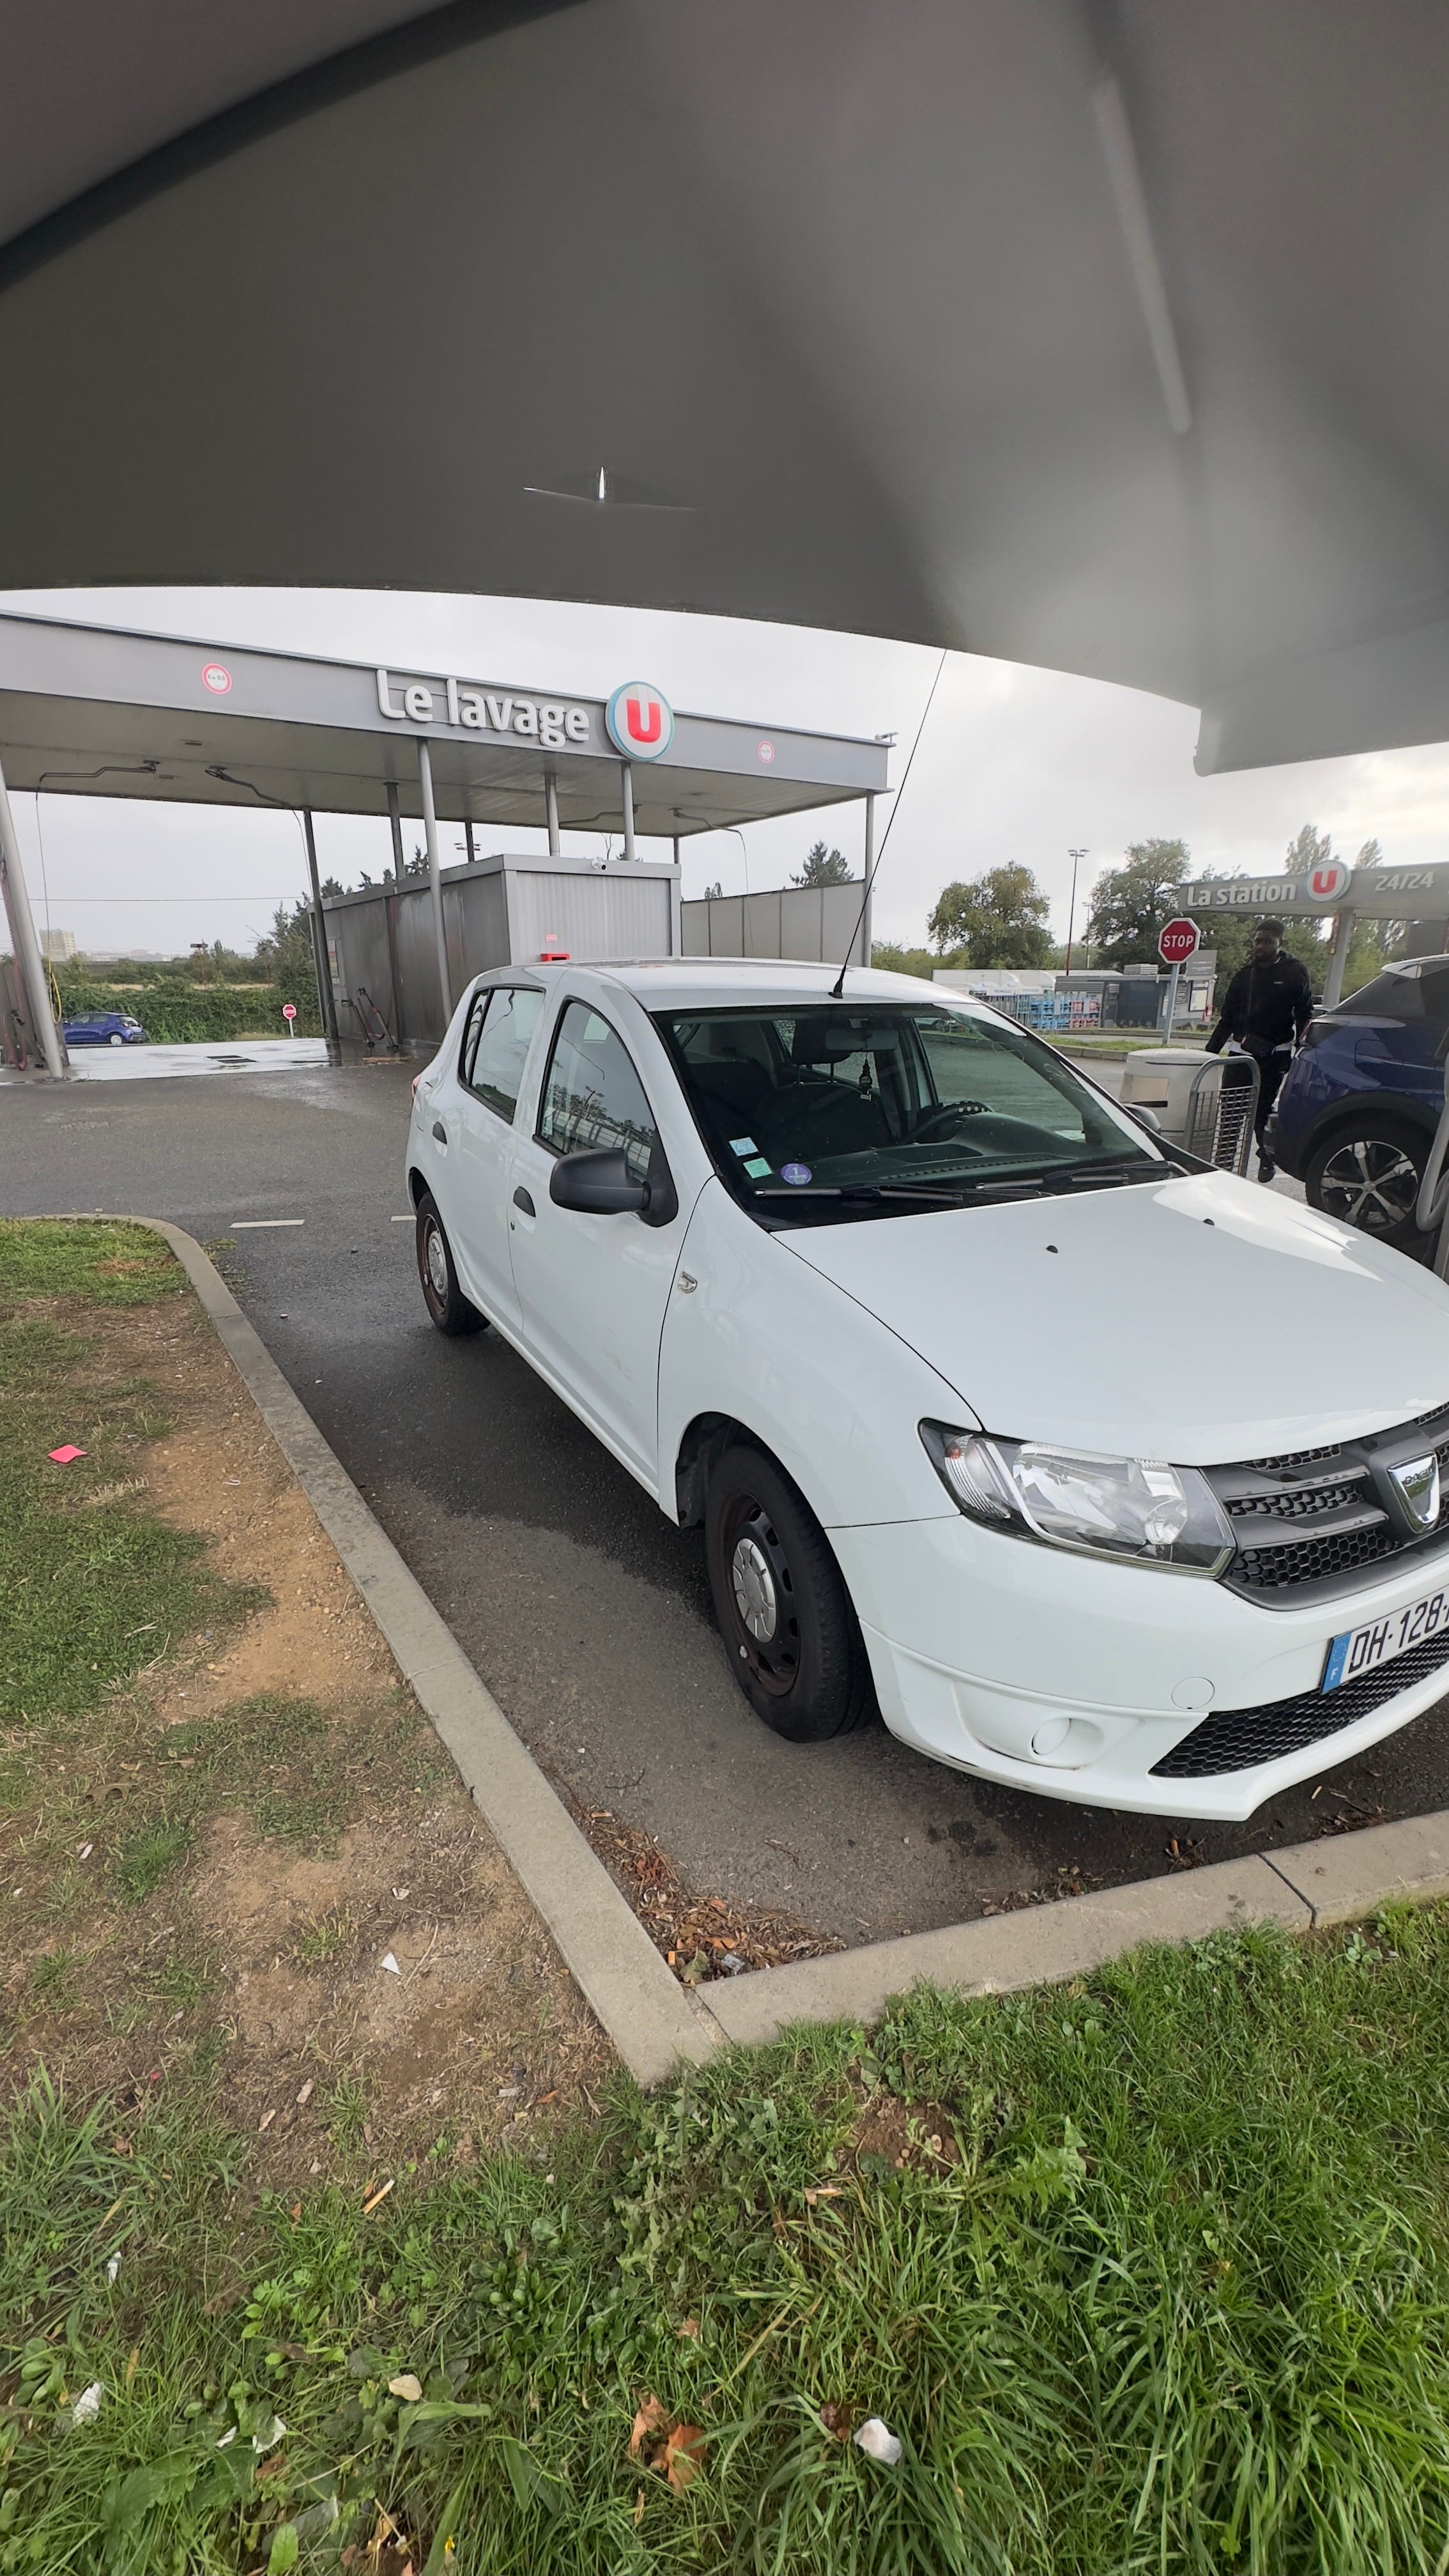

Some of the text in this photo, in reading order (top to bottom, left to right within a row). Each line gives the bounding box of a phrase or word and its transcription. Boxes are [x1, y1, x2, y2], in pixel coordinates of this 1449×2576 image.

[378, 670, 661, 747] Le lavage U
[1187, 871, 1434, 907] La station U 24/24
[1163, 935, 1194, 948] STOP
[1330, 1593, 1449, 1680] F DH-128-
